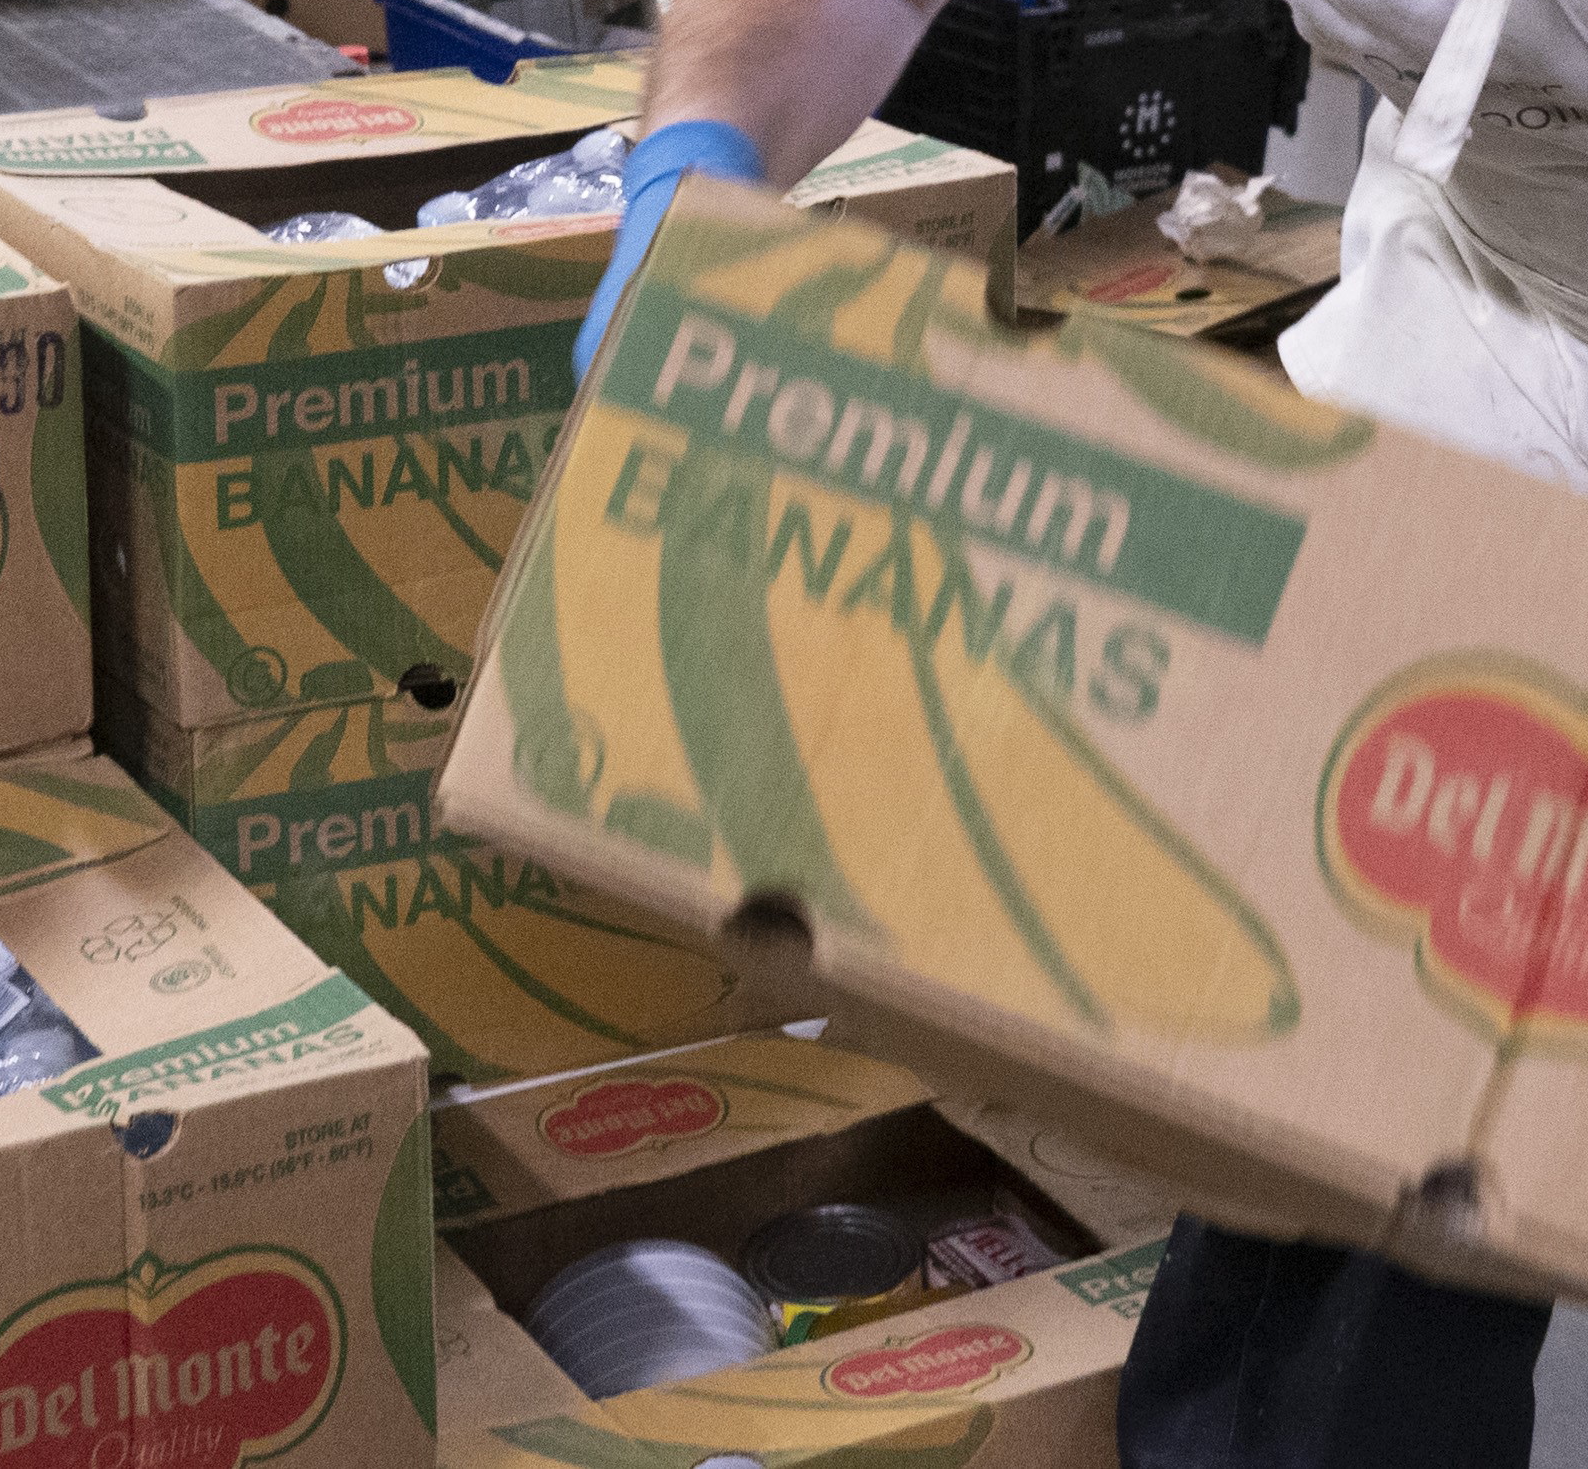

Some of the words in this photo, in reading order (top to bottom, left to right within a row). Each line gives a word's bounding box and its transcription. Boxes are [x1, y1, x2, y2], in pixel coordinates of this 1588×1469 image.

[213, 357, 532, 446] Premium
[652, 311, 1132, 577] Premium
[604, 443, 1172, 721] BANANAS
[236, 801, 442, 873] Prem
[1370, 731, 1511, 861] Del
[62, 1021, 299, 1110] Premium
[113, 1321, 316, 1422] Monte
[839, 1360, 899, 1393] Del
[900, 1332, 1007, 1374] Monte
